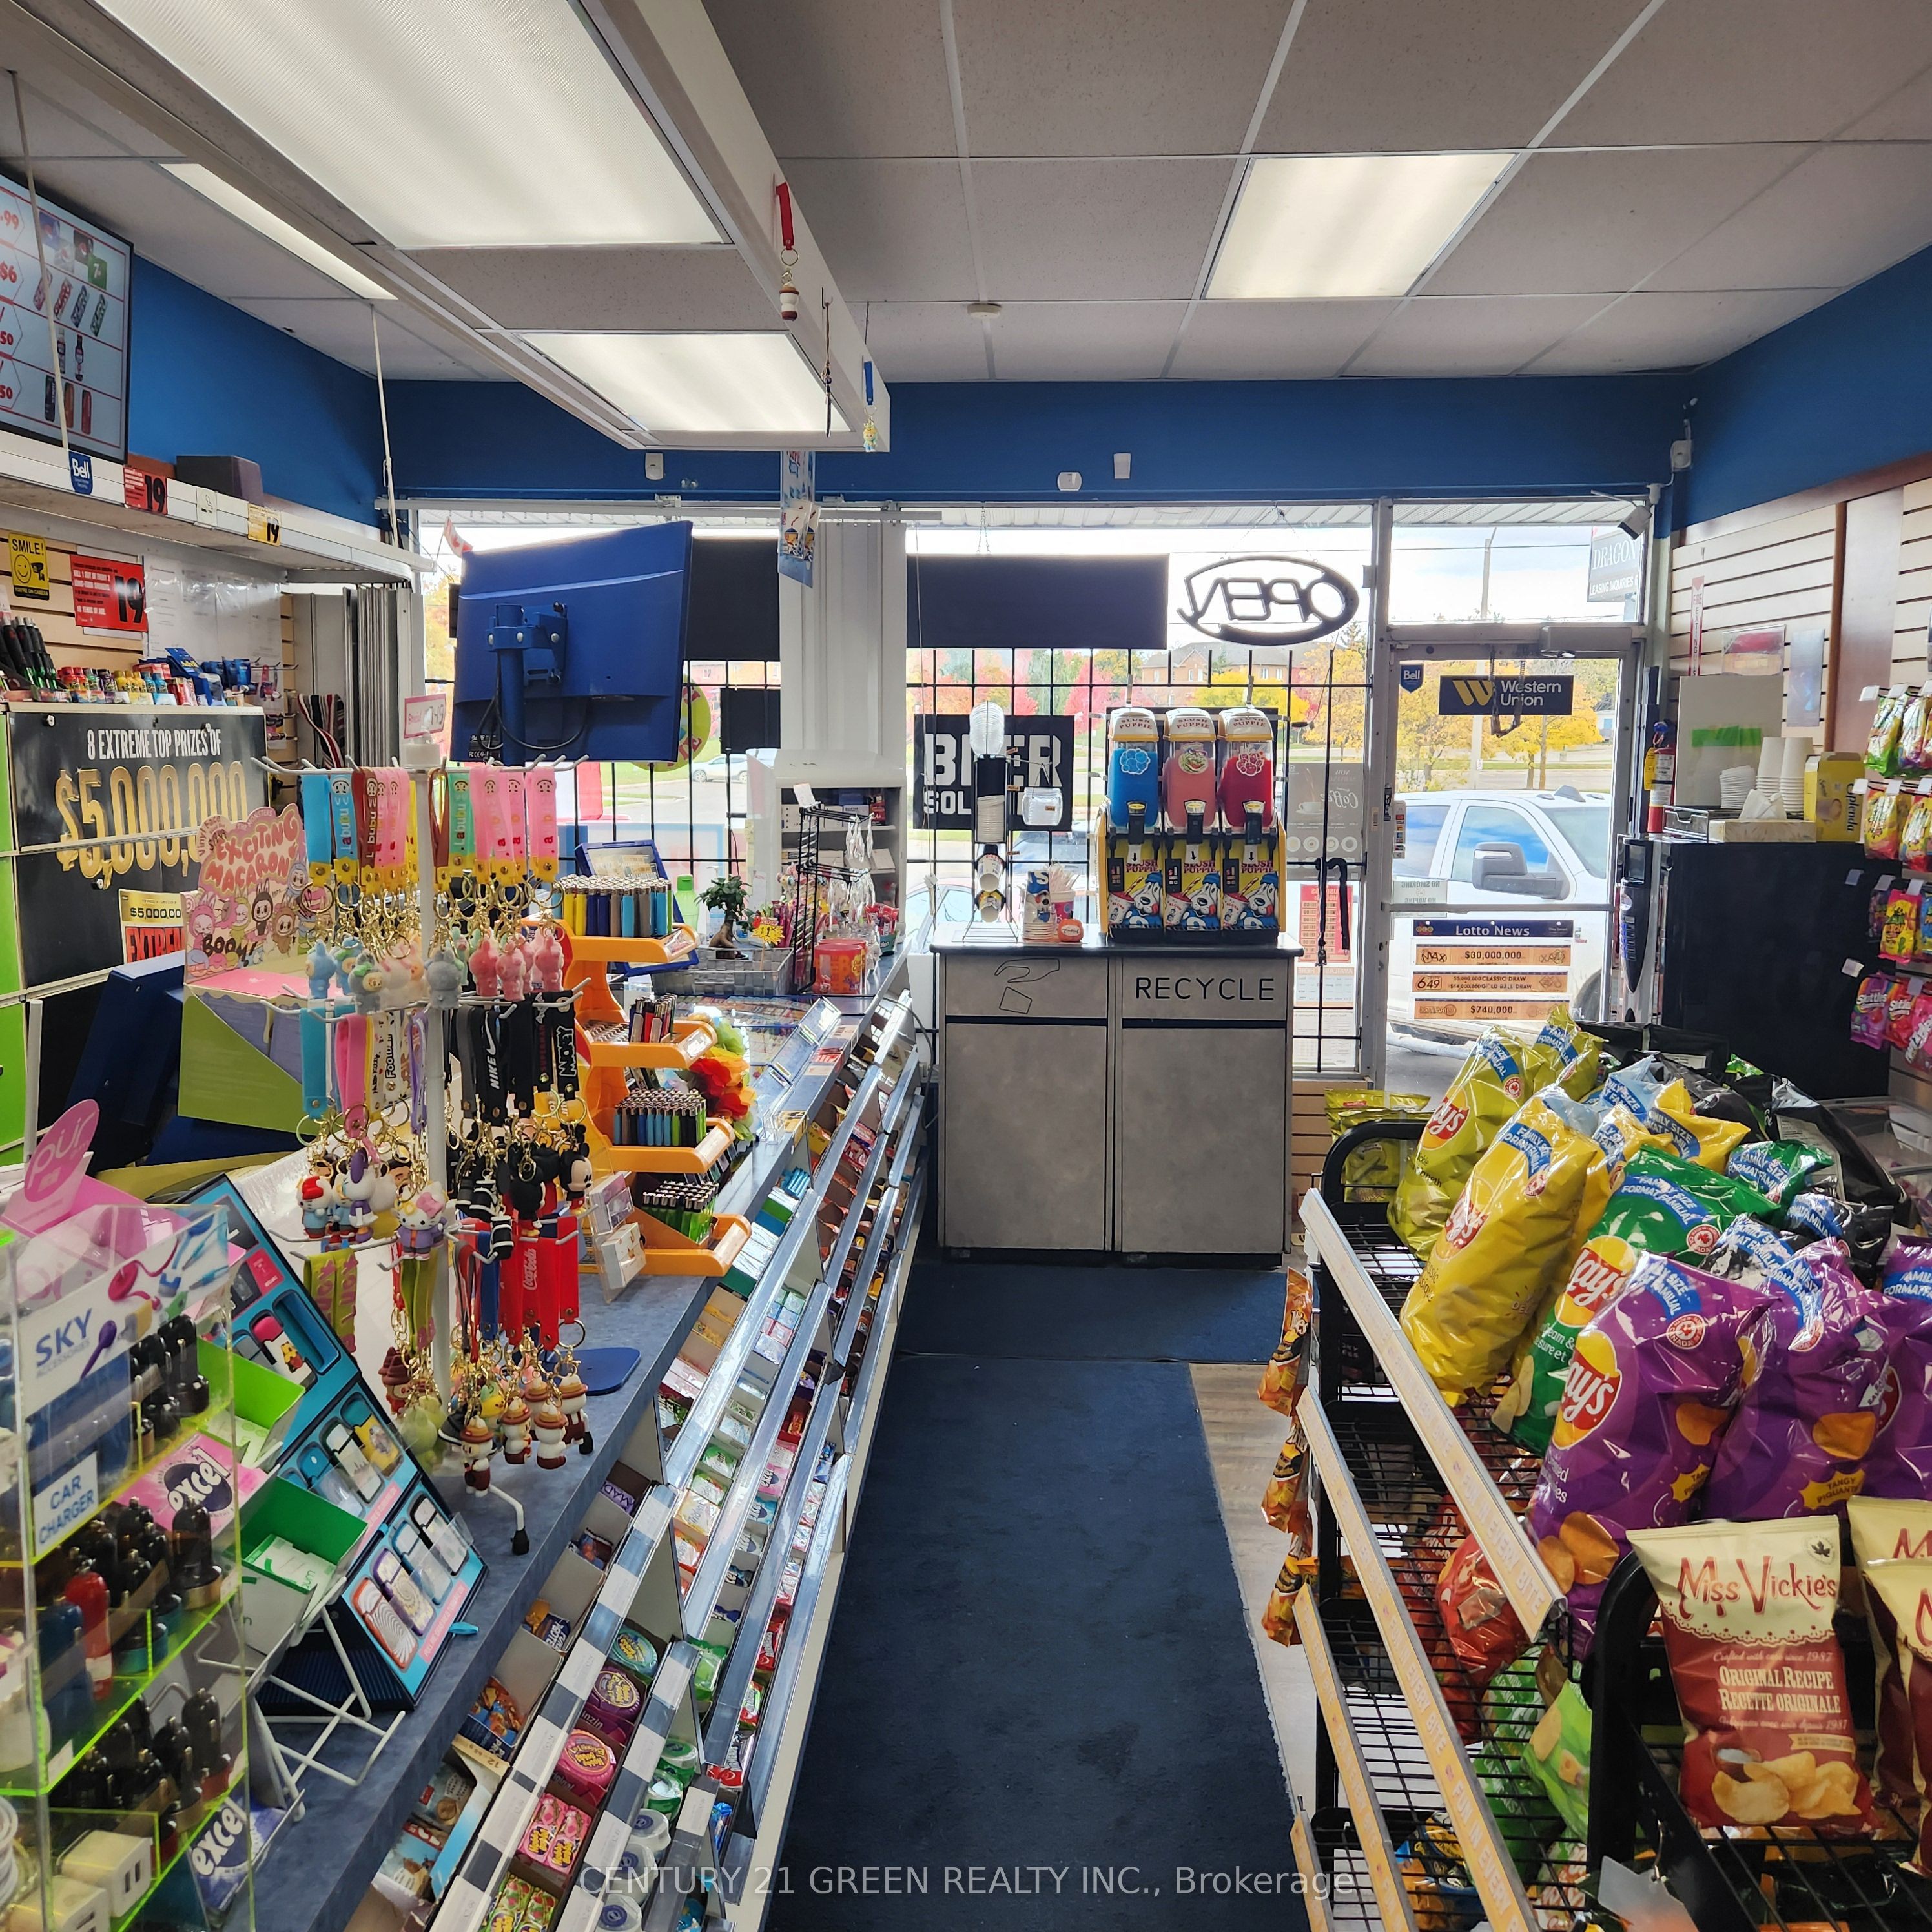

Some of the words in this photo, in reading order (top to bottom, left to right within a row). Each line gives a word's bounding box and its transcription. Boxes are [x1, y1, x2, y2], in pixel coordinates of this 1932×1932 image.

[72, 458, 90, 479] Bell
[144, 474, 167, 515] 19
[12, 539, 44, 556] SMILE!
[1592, 538, 1638, 570] DRAGON
[114, 575, 145, 624] 19
[1403, 670, 1421, 681] Bell
[1499, 680, 1561, 694] Western
[1499, 693, 1544, 706] Union
[87, 729, 96, 760] 8
[99, 728, 152, 760] EXTREME
[152, 730, 171, 759] TOP
[174, 728, 209, 757] PRIZES
[209, 728, 221, 756] OF
[216, 812, 299, 866] EXCITING
[205, 850, 290, 891] MACARON
[1455, 925, 1490, 936] Lotto
[1494, 925, 1530, 936] News
[1464, 951, 1522, 960] $30,000,000
[1135, 977, 1275, 1001] RECYCLE
[1470, 1005, 1513, 1015] $740,000
[486, 1054, 501, 1090] NIKE
[1670, 1123, 1694, 1144] SIZE
[1674, 1193, 1698, 1209] SIZE
[1666, 1273, 1689, 1297] SIZE
[36, 1308, 92, 1368] SKY
[50, 1475, 81, 1510] CAR
[1826, 1476, 1857, 1490] TANGY
[38, 1489, 94, 1545] CHARGER
[1515, 1568, 1545, 1616] BITE
[1678, 1556, 1741, 1619] Miss
[1735, 1555, 1837, 1614] Vickie's
[1806, 1651, 1834, 1663] 1987
[1718, 1665, 1783, 1688] ORIGINAL
[1782, 1666, 1834, 1690] RECIPE
[1718, 1688, 1774, 1711] RECETTE
[1776, 1692, 1842, 1714] ORIGINALE
